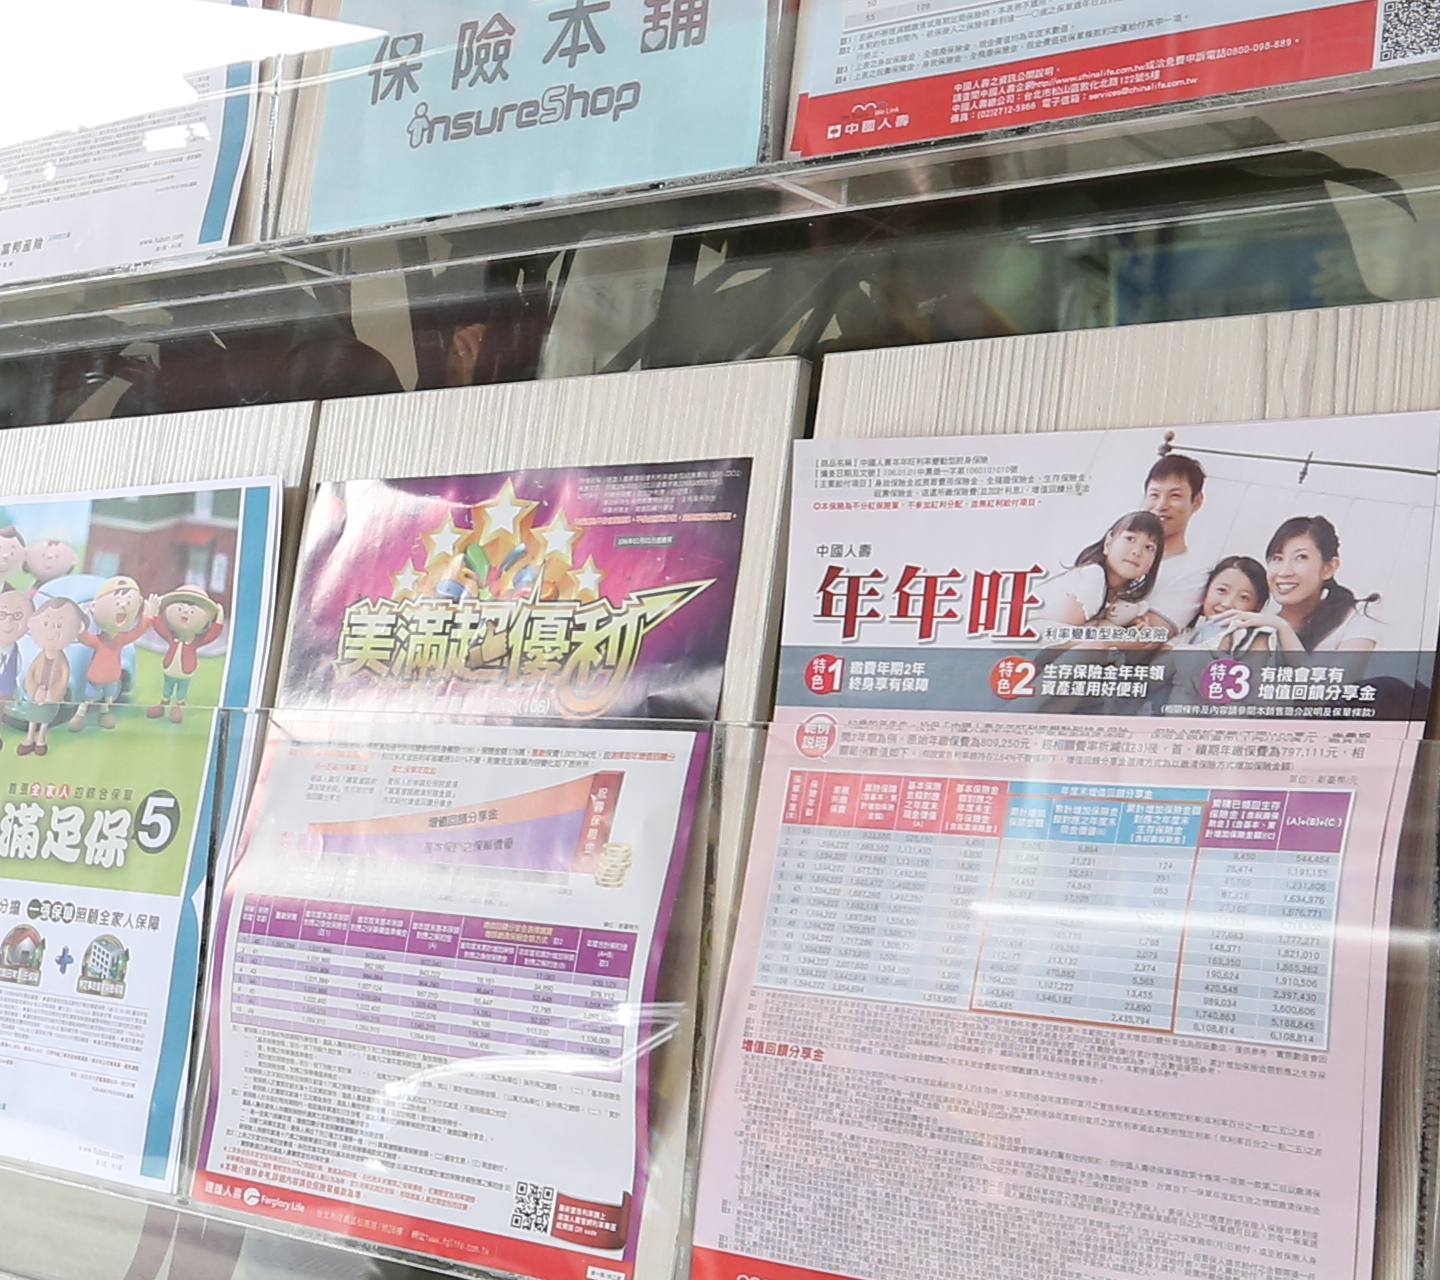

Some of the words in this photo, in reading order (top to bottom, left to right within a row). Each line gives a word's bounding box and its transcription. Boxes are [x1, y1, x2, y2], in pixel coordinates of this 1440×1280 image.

[845, 115, 910, 138] 中國人壽
[1, 237, 44, 256] 富邦產險
[816, 543, 871, 559] 中國人壽
[812, 562, 1049, 642] 年年旺
[334, 588, 654, 691] 美滿超優利
[811, 658, 826, 690] 特色
[827, 659, 843, 692] 1
[849, 661, 925, 677] 繳費年期2年
[997, 663, 1012, 696] 特色
[1013, 662, 1035, 696] 2
[1042, 663, 1164, 683] 生存保險金年年領
[1260, 667, 1343, 684] 有機會享有
[848, 675, 929, 693] 終身享有保障
[1041, 680, 1147, 700] 資產運用好便利
[1209, 665, 1225, 699] 特色
[1225, 663, 1249, 700] 3
[1258, 684, 1376, 702] 增值回饋分享金
[138, 796, 174, 848] 5
